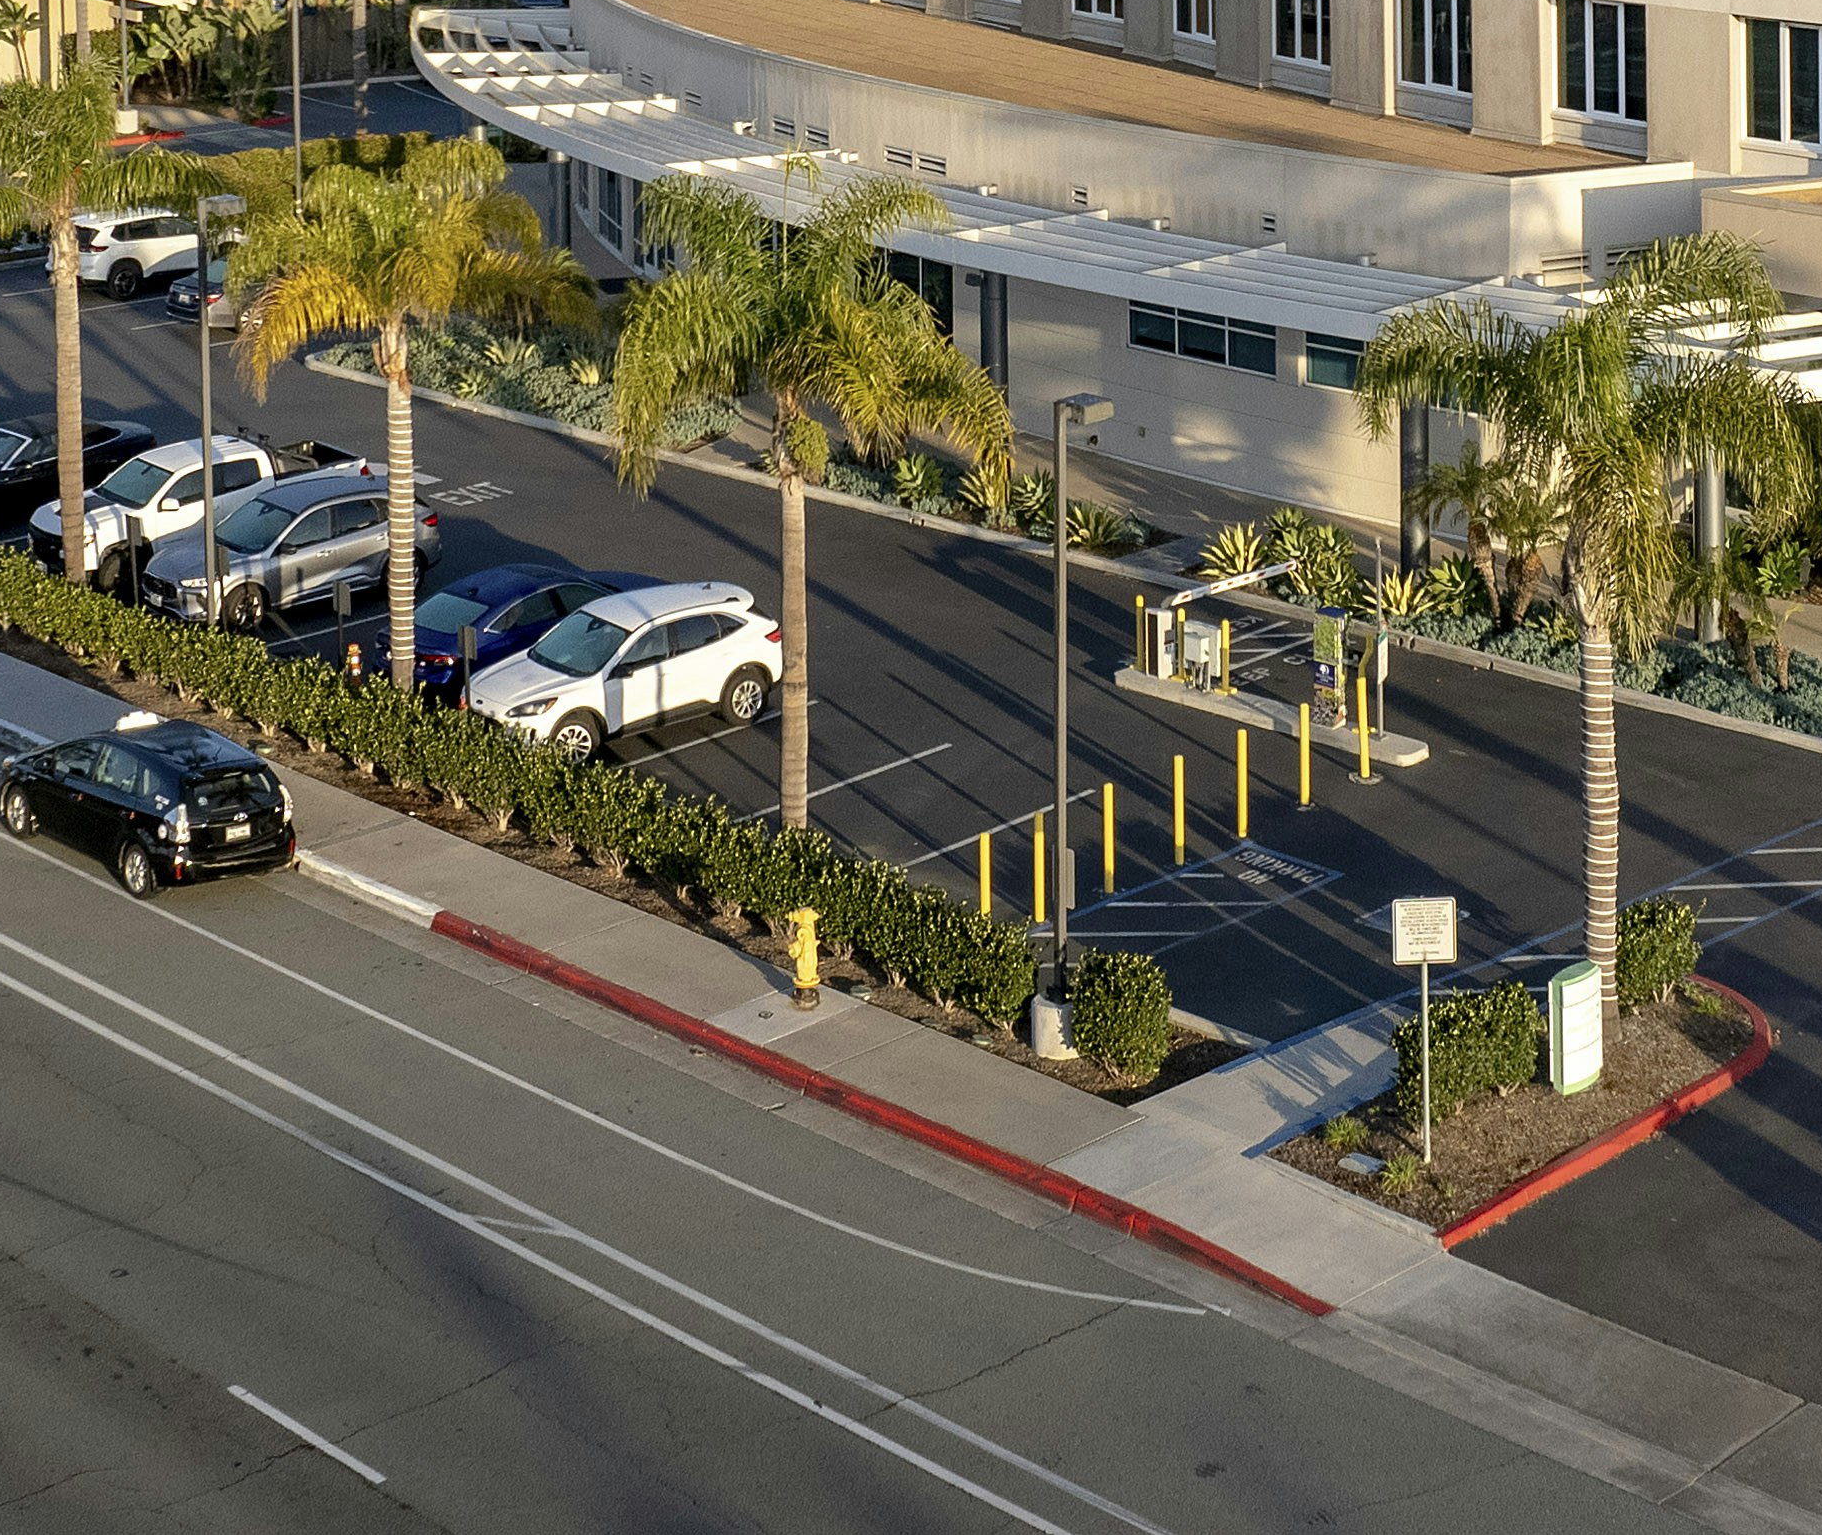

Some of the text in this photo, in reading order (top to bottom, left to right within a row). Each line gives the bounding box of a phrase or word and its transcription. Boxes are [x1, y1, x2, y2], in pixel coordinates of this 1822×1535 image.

[428, 481, 514, 506] EXIT
[1234, 850, 1324, 884] PARKING
[1238, 869, 1275, 885] NO
